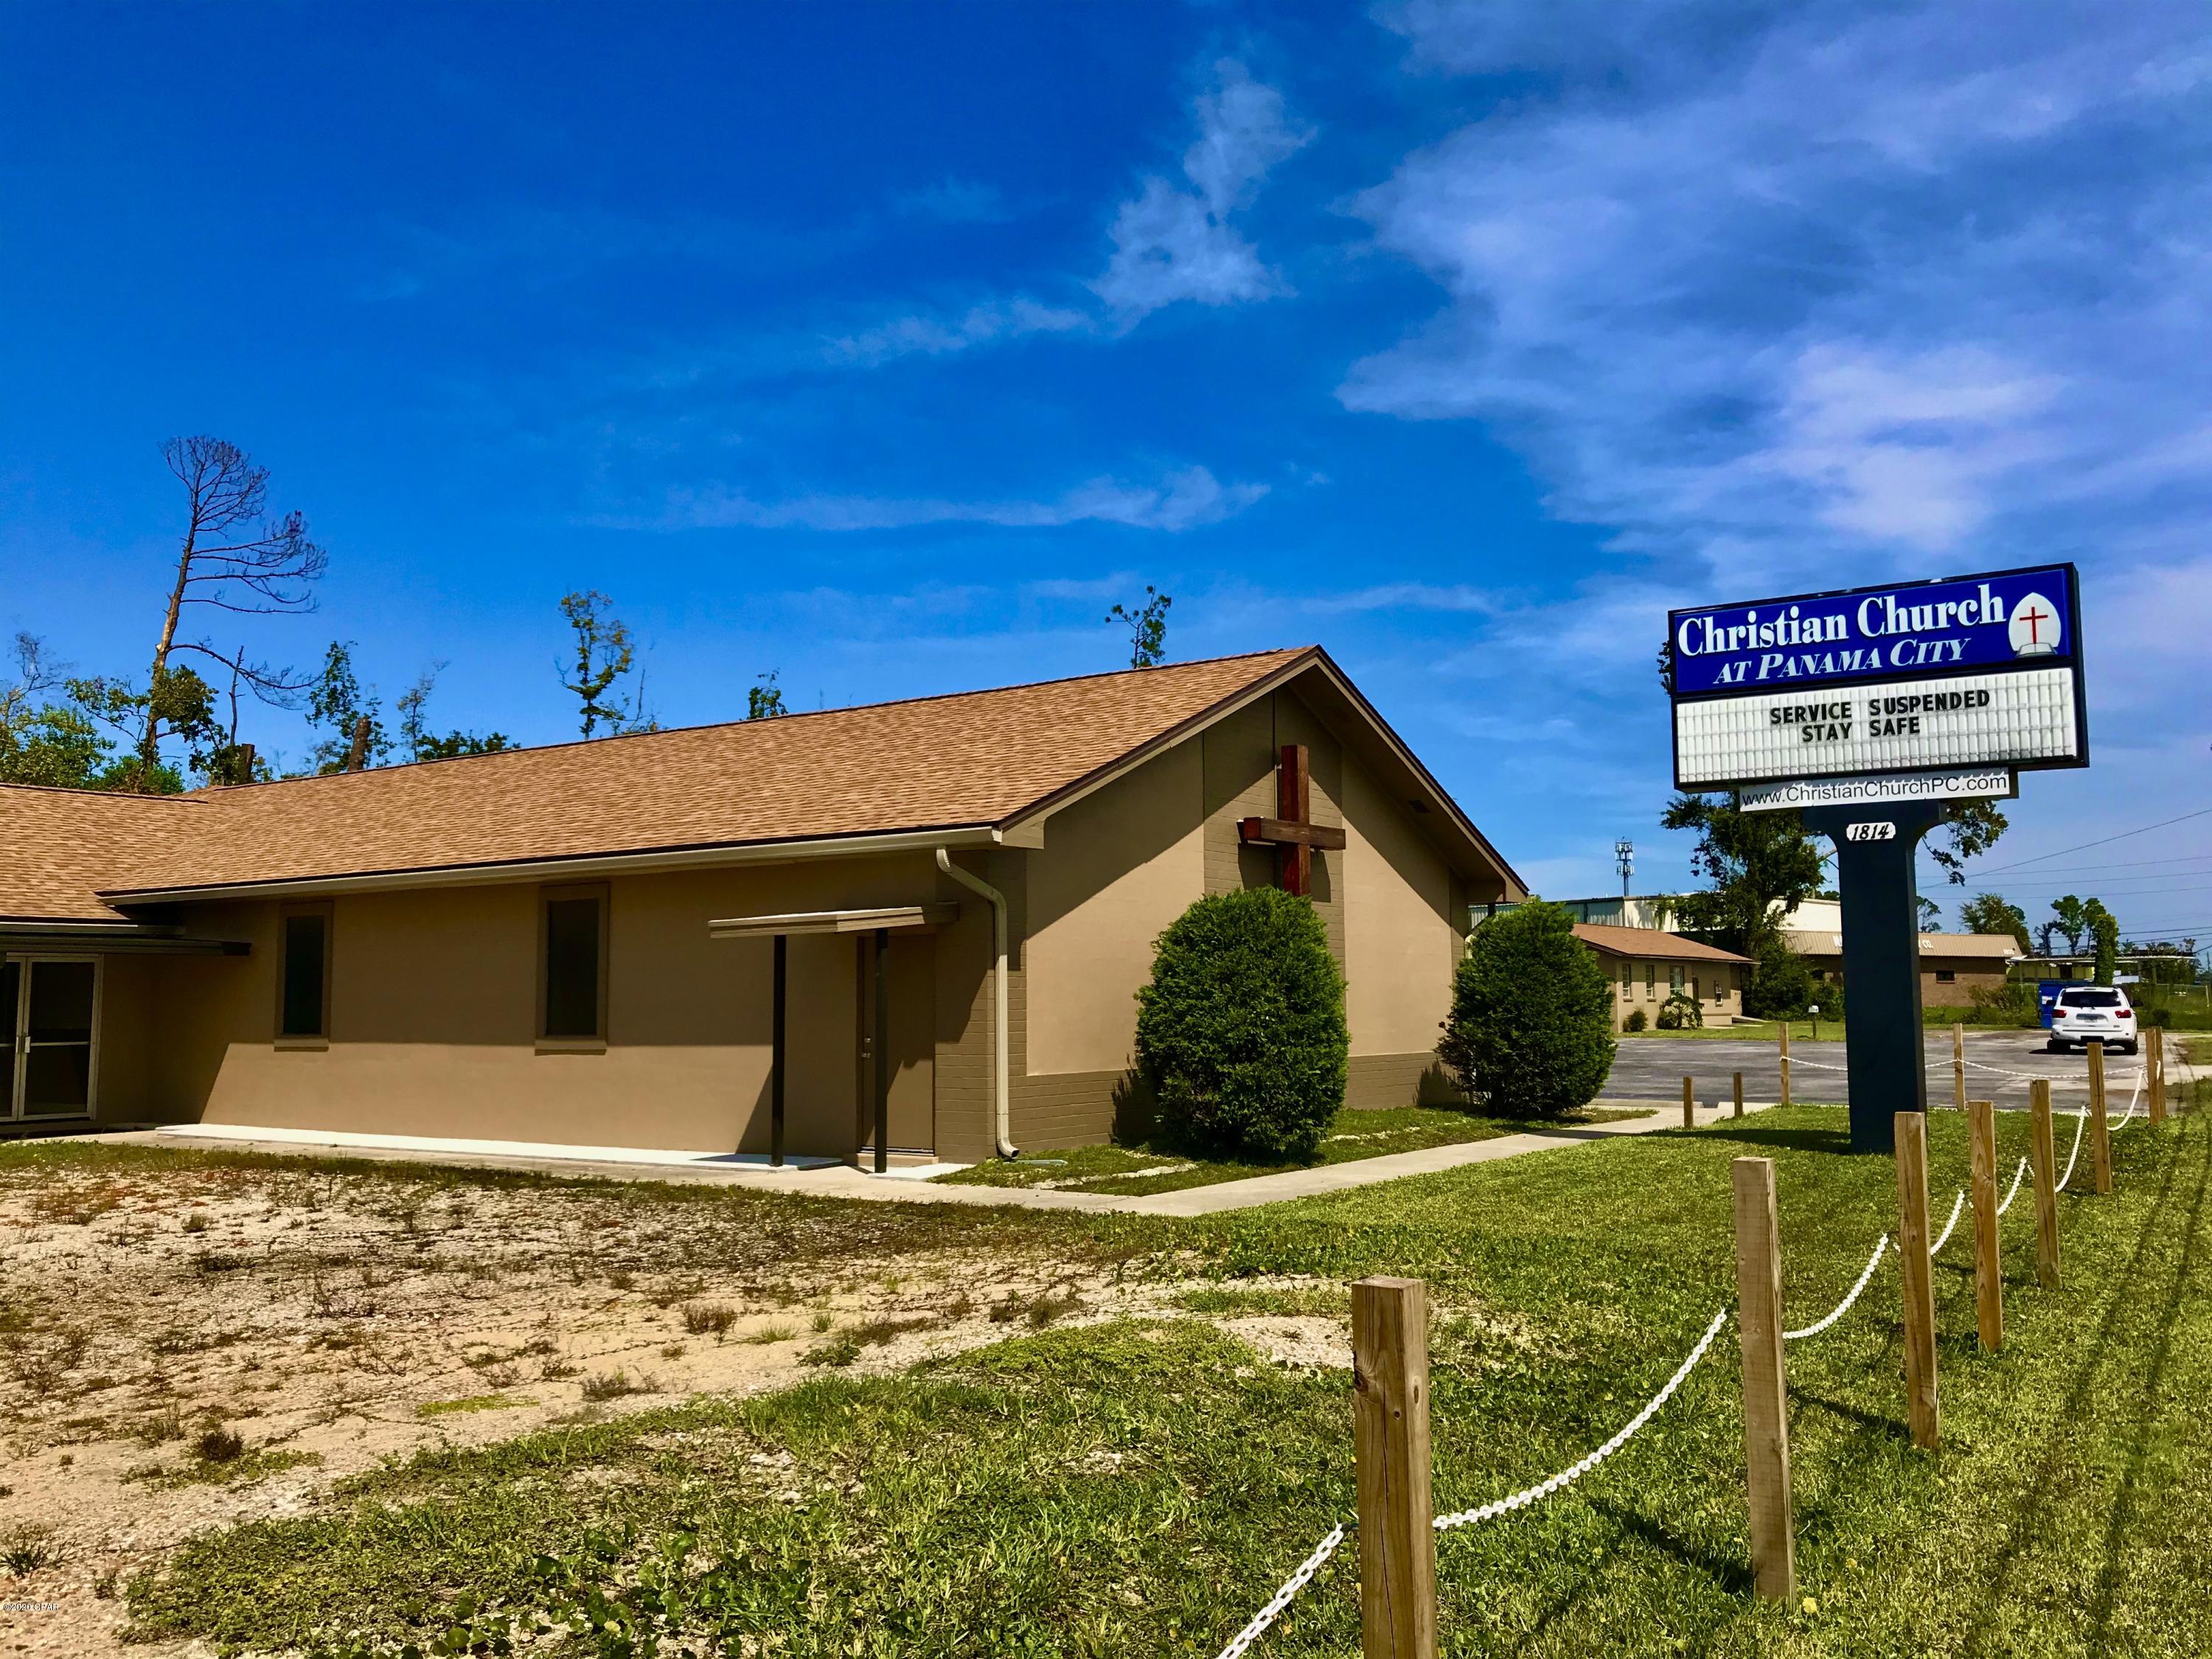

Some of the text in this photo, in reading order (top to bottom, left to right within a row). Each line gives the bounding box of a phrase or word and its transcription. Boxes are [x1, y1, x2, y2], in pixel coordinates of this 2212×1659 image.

[1678, 584, 2006, 656] Christian Church
[1713, 639, 1972, 684] AT PANAMA CITY
[1770, 689, 1989, 724] SERVICE SUSPENDED
[1802, 716, 1920, 742] STAY SAFE
[1742, 776, 2007, 806] www.ChristianChurchPC.com
[1852, 824, 1890, 840] 1814
